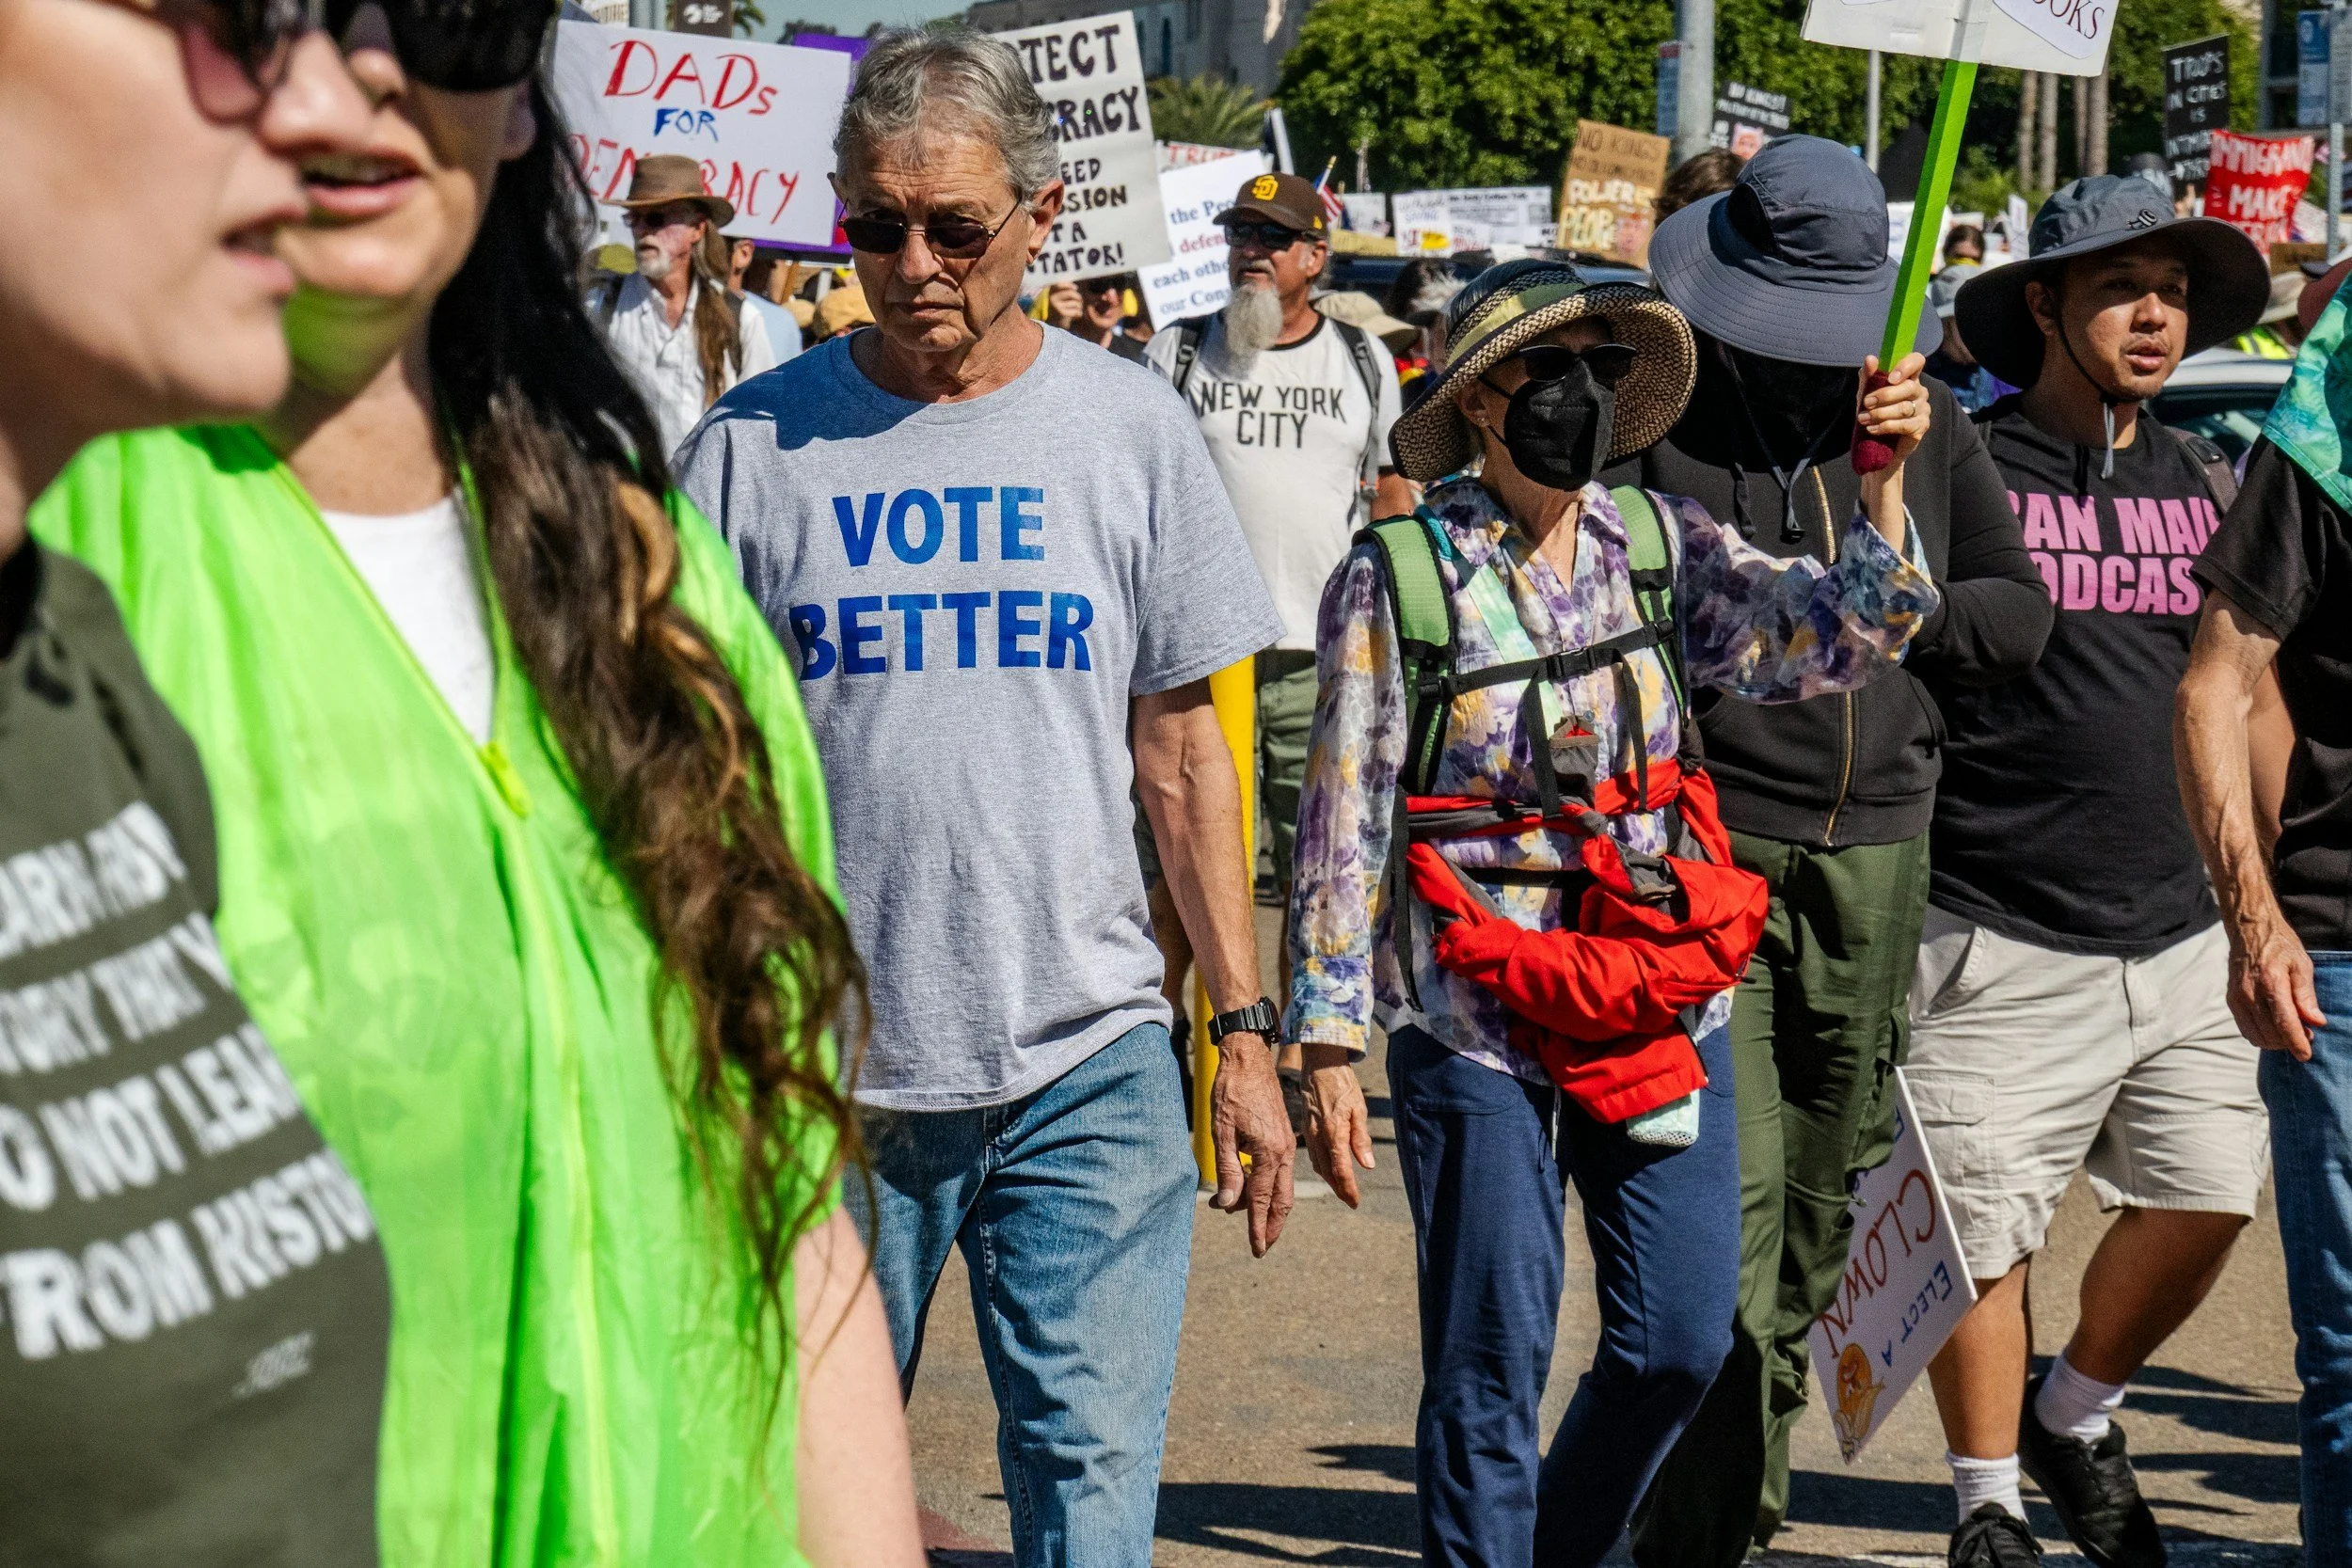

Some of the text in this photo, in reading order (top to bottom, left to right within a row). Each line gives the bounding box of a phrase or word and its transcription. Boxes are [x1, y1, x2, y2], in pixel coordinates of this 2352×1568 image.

[2034, 0, 2105, 40] OKS
[653, 107, 718, 142] FOR
[570, 134, 800, 226] DEMRACY
[1057, 184, 1128, 216] SION
[1169, 207, 1200, 226] the
[1152, 266, 1190, 290] each
[1199, 381, 1347, 424] NEW YORK
[1236, 409, 1311, 450] CITY
[832, 485, 1045, 568] VOTE
[2006, 488, 2104, 553] AN
[788, 590, 1094, 682] BETTER
[38, 1072, 187, 1203] NOT
[0, 1218, 215, 1361] ROM
[1819, 1167, 1937, 1361] CLOWN
